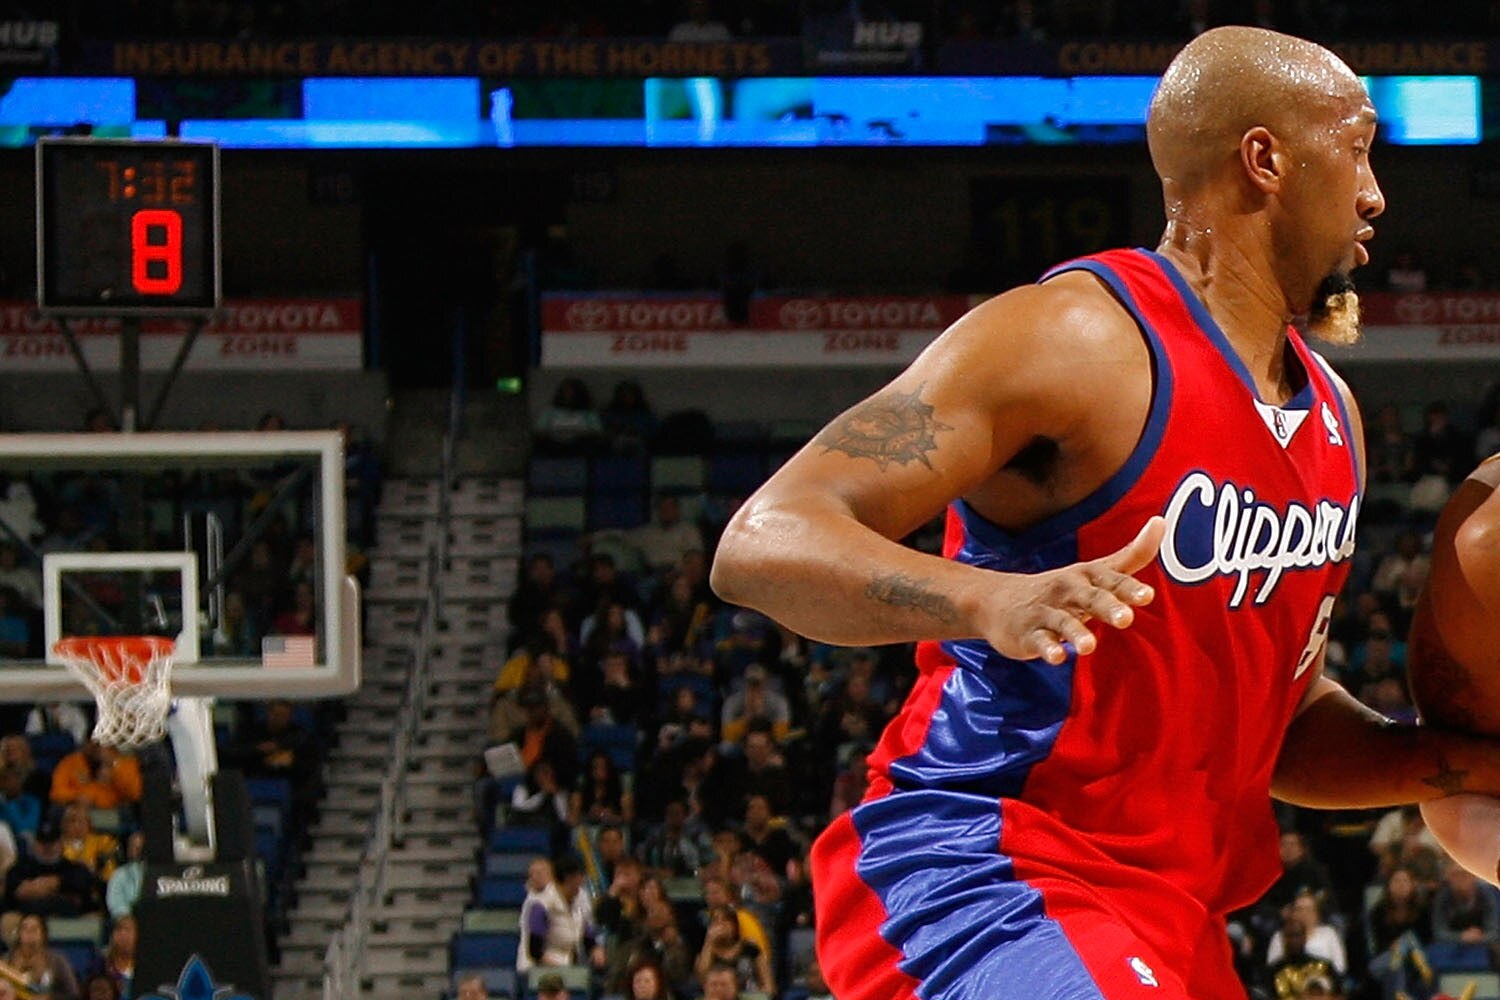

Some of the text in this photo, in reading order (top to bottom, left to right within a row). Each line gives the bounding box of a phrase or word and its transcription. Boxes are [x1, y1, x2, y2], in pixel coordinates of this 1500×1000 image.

[113, 42, 771, 75] INSURANCE AGENCY OF THE HORNETS
[97, 158, 197, 203] 7:32
[130, 208, 184, 297] 8
[222, 305, 340, 328] TOYOTA
[615, 303, 730, 326] TOYOTA
[827, 301, 940, 325] TOYOTA
[222, 335, 298, 354] ZONE
[610, 334, 689, 352] ZONE
[822, 332, 901, 352] ZONE
[1158, 470, 1358, 609] Clippers
[156, 876, 229, 896] SPALDING
